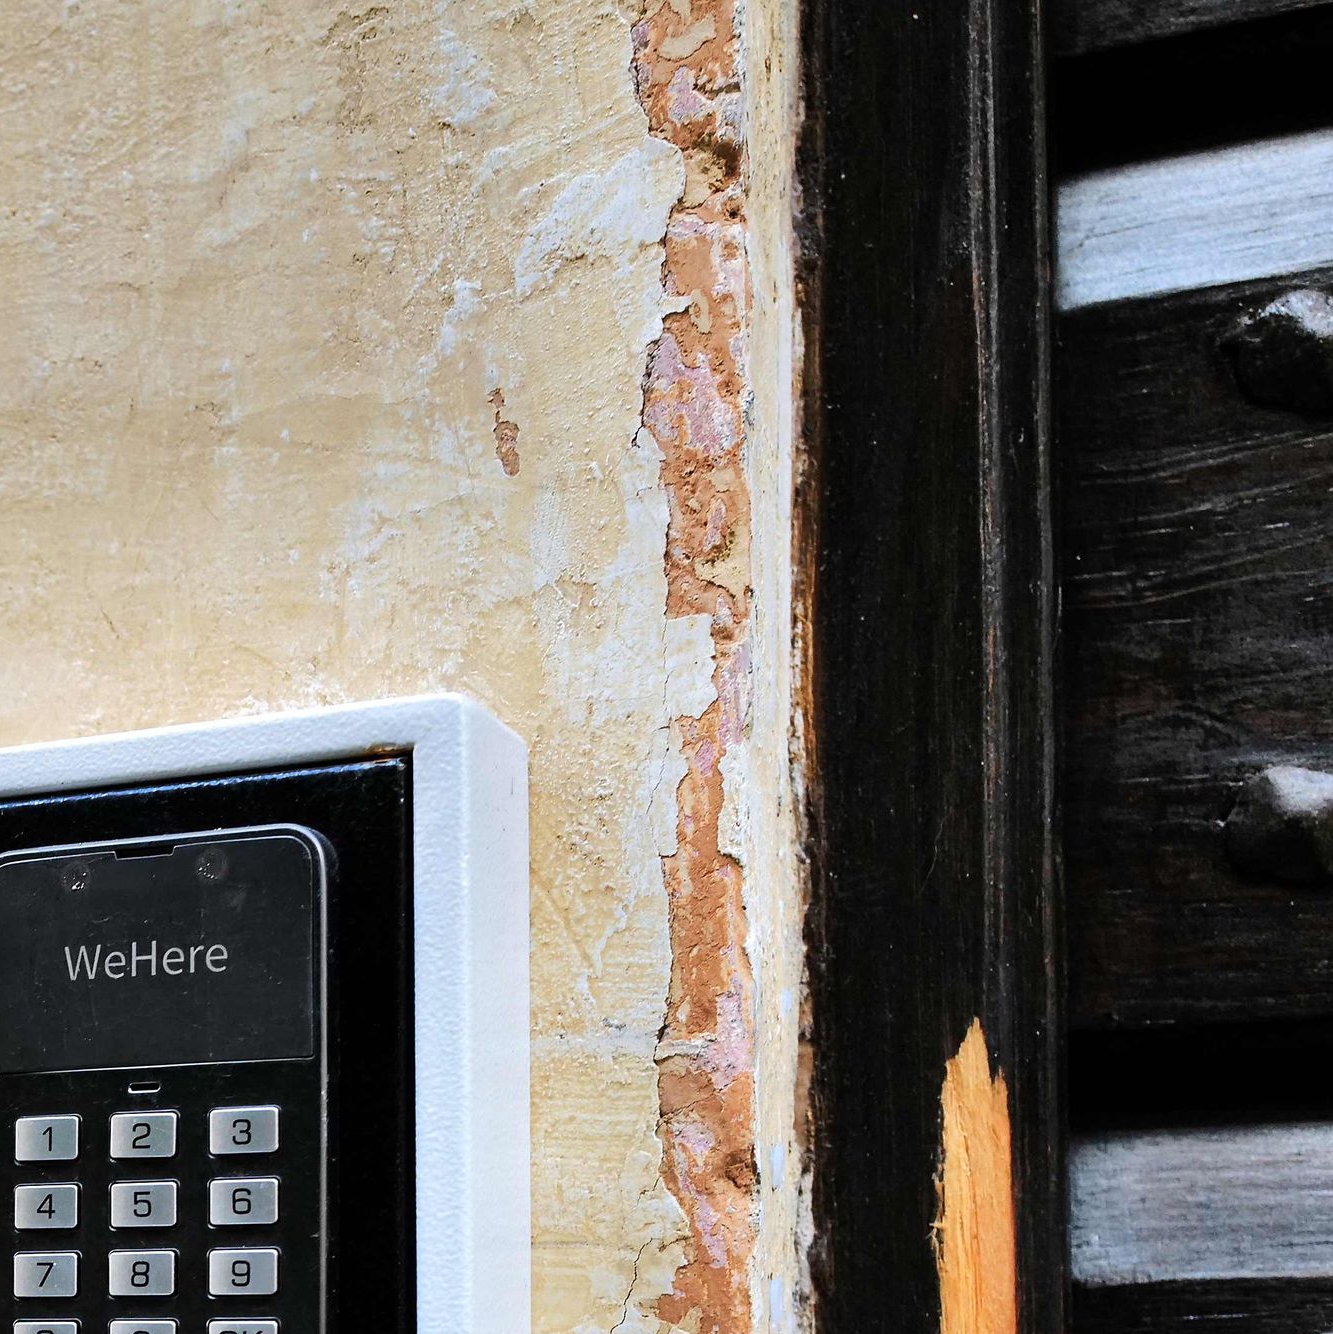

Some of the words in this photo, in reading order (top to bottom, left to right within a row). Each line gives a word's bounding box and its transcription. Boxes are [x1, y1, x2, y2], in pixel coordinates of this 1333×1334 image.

[65, 940, 228, 981] WeHere
[41, 1126, 54, 1152] 1
[131, 1122, 152, 1150] 2
[231, 1118, 252, 1146] 3
[36, 1193, 56, 1220] 4
[133, 1190, 152, 1218] 5
[231, 1187, 252, 1215] 6
[36, 1262, 54, 1288] 7
[130, 1260, 151, 1288] 8
[231, 1259, 251, 1288] 9
